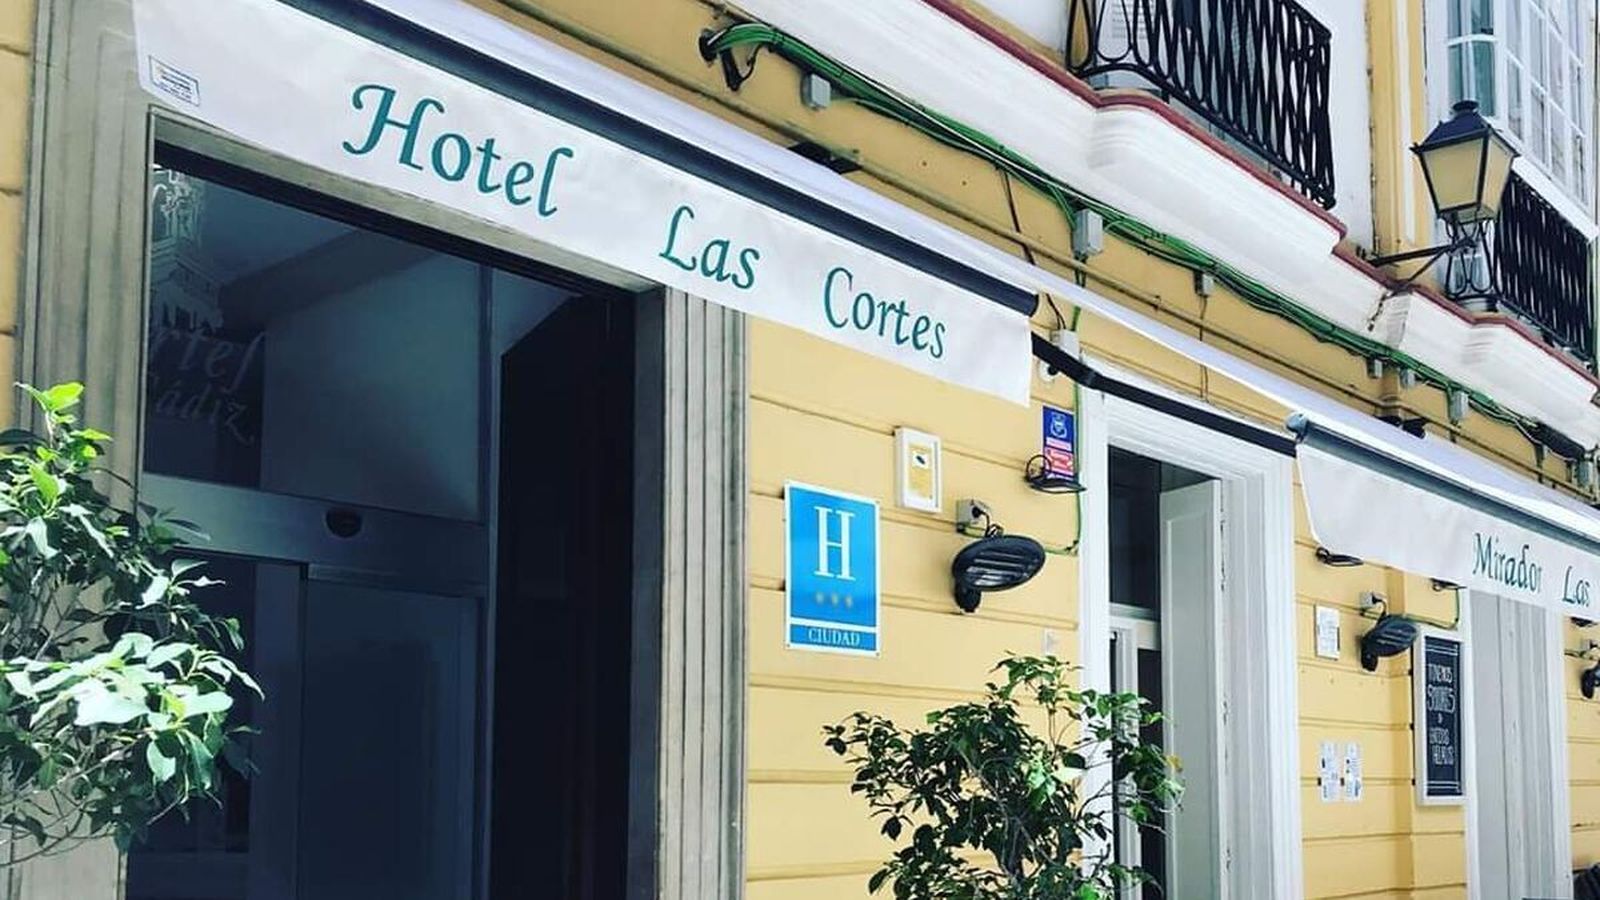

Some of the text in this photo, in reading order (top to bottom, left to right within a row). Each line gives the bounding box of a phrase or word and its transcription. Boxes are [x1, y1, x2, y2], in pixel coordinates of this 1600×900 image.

[343, 84, 946, 359] Hotel Las Cortes
[814, 506, 856, 582] H
[1472, 533, 1590, 607] Mirador Las
[808, 627, 861, 646] CIUDAD
